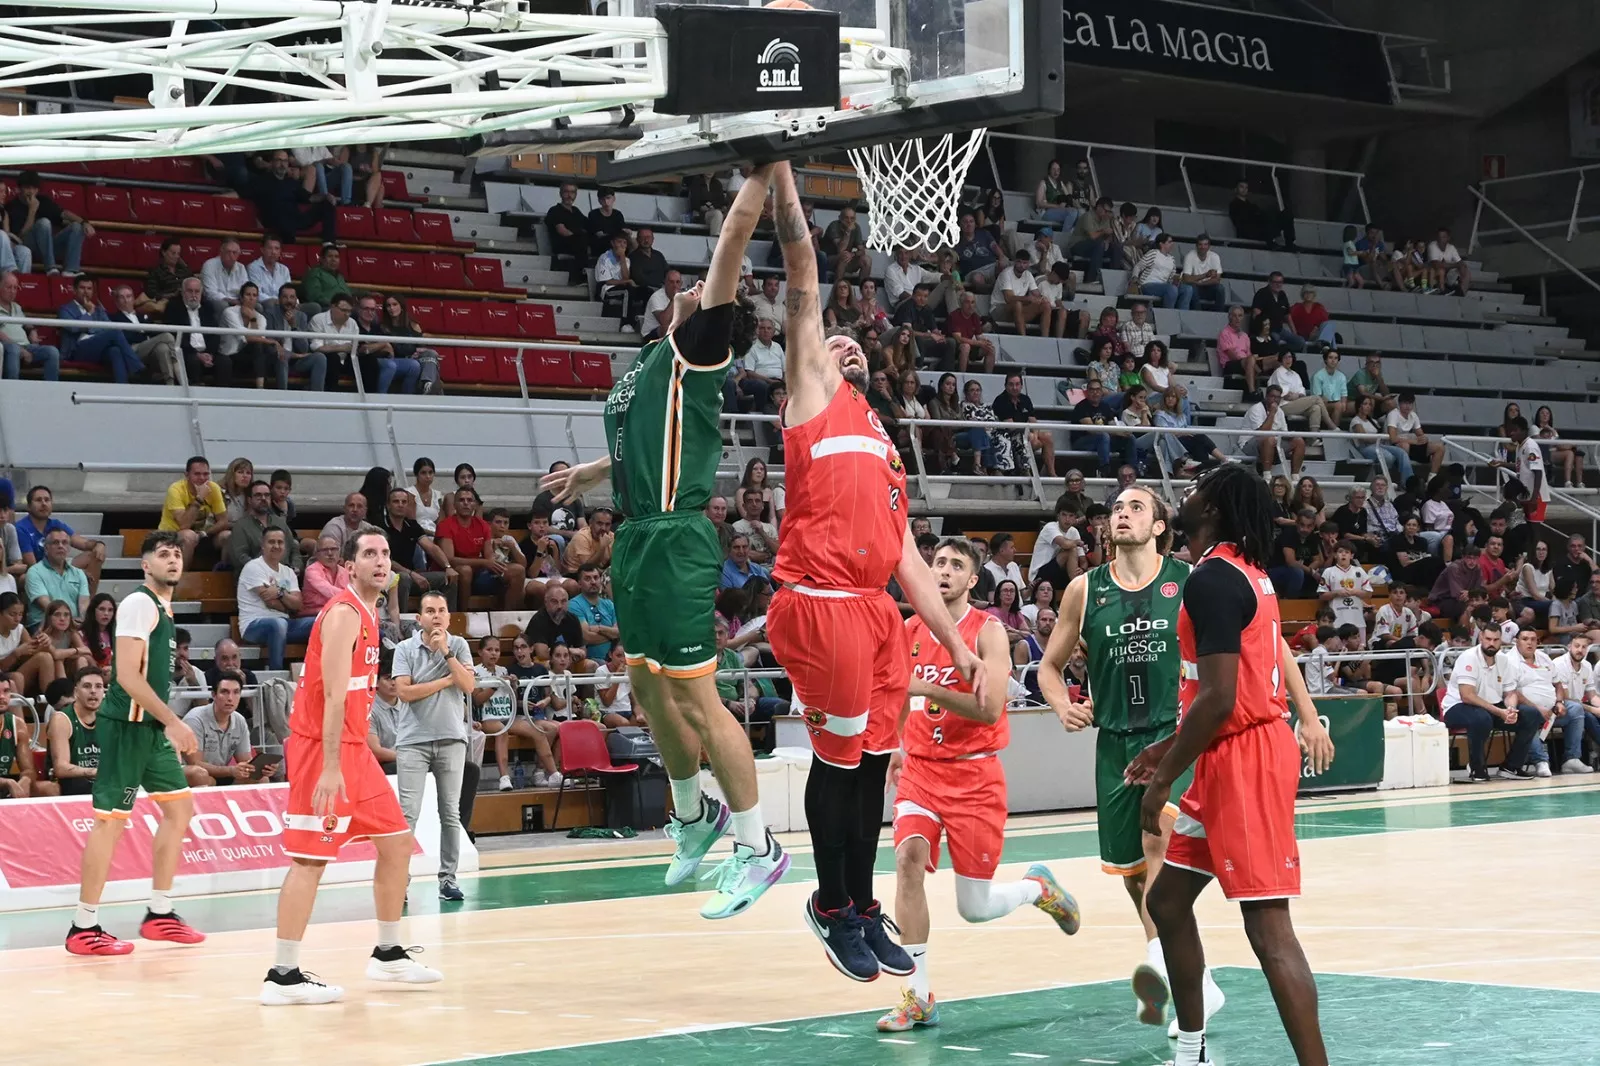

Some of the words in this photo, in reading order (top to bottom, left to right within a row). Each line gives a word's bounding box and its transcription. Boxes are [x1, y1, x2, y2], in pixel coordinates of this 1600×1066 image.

[1105, 617, 1169, 637] Lobe
[1129, 675, 1145, 705] 1
[932, 726, 944, 744] 5
[183, 847, 218, 864] HIGH
[221, 844, 275, 860] QUALITY
